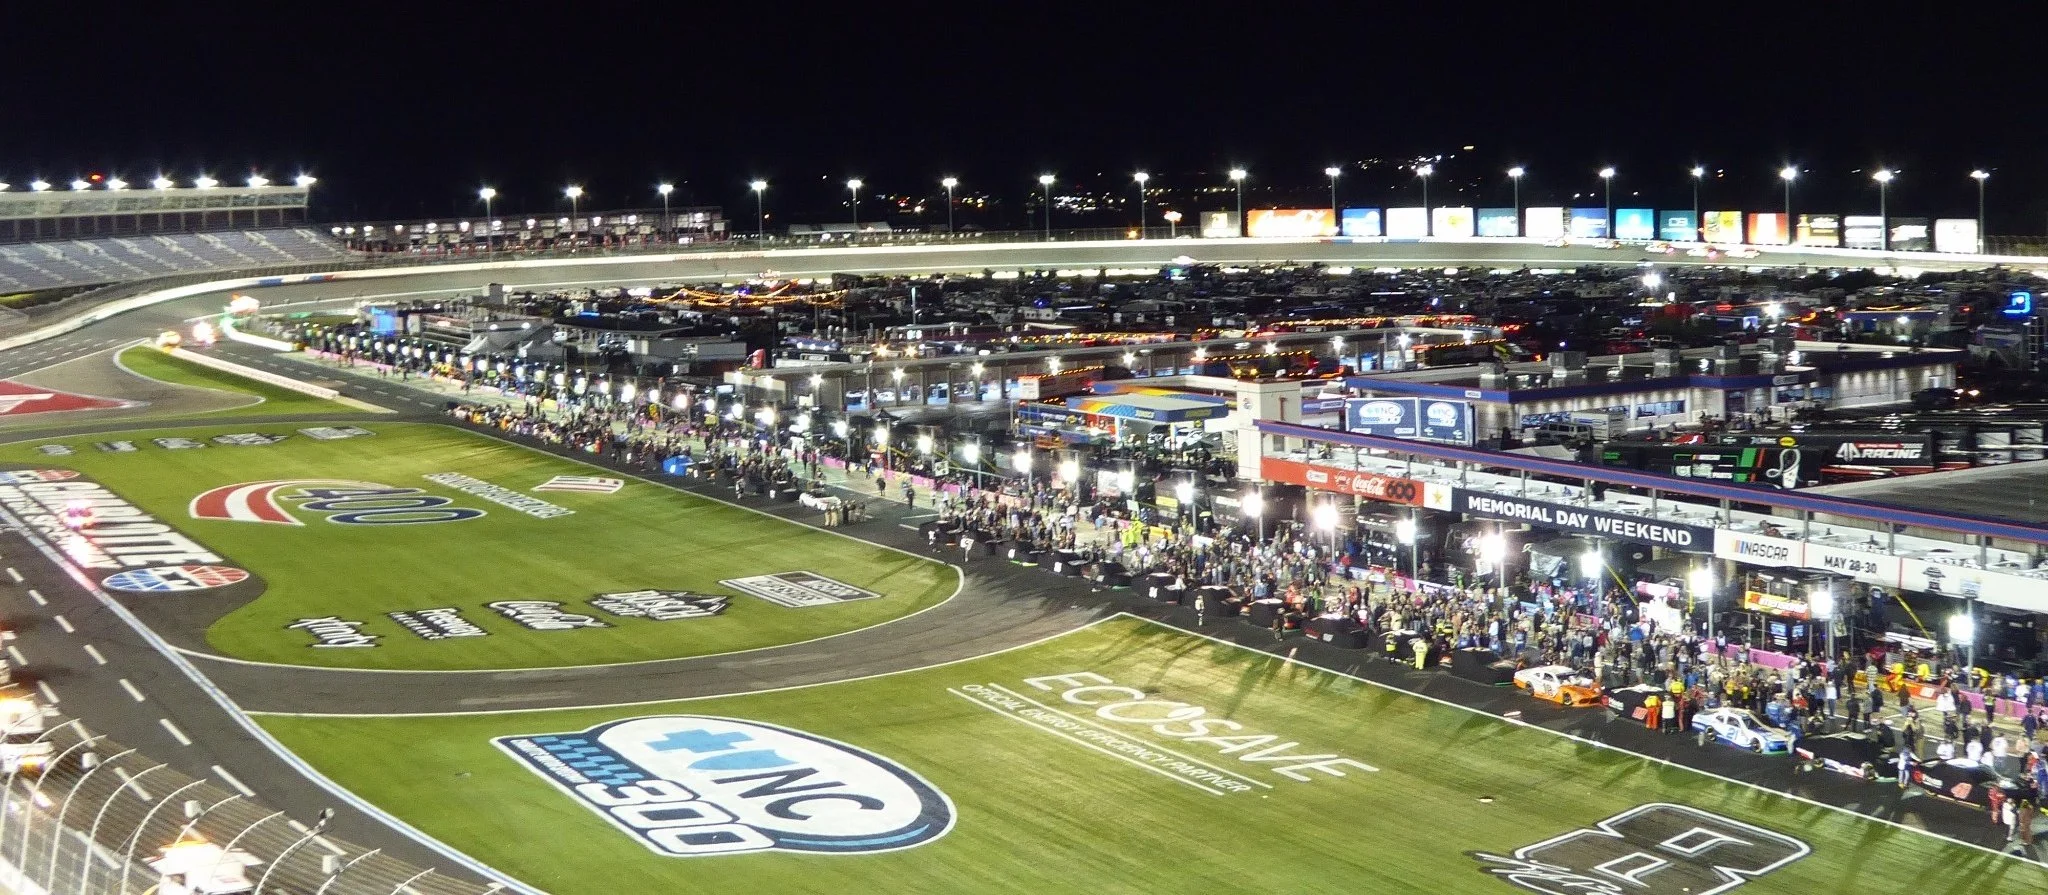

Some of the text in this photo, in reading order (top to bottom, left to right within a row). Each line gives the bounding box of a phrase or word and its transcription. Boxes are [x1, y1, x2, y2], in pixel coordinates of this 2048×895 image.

[1861, 448, 1922, 459] RACING
[281, 488, 488, 525] 400
[1386, 480, 1416, 501] 600
[19, 481, 224, 567] CHARLOTTE
[1467, 496, 1692, 546] MEMORIAL DAY WEEKEND
[1744, 543, 1789, 561] NASCAR
[1824, 554, 1878, 575] MAY 28-30
[961, 684, 1252, 792] OFFICIAL ENERGY EFFICIENCY PARTNER
[1023, 671, 1380, 782] ECOSAVE
[576, 779, 776, 855] 300
[711, 767, 886, 821] NC
